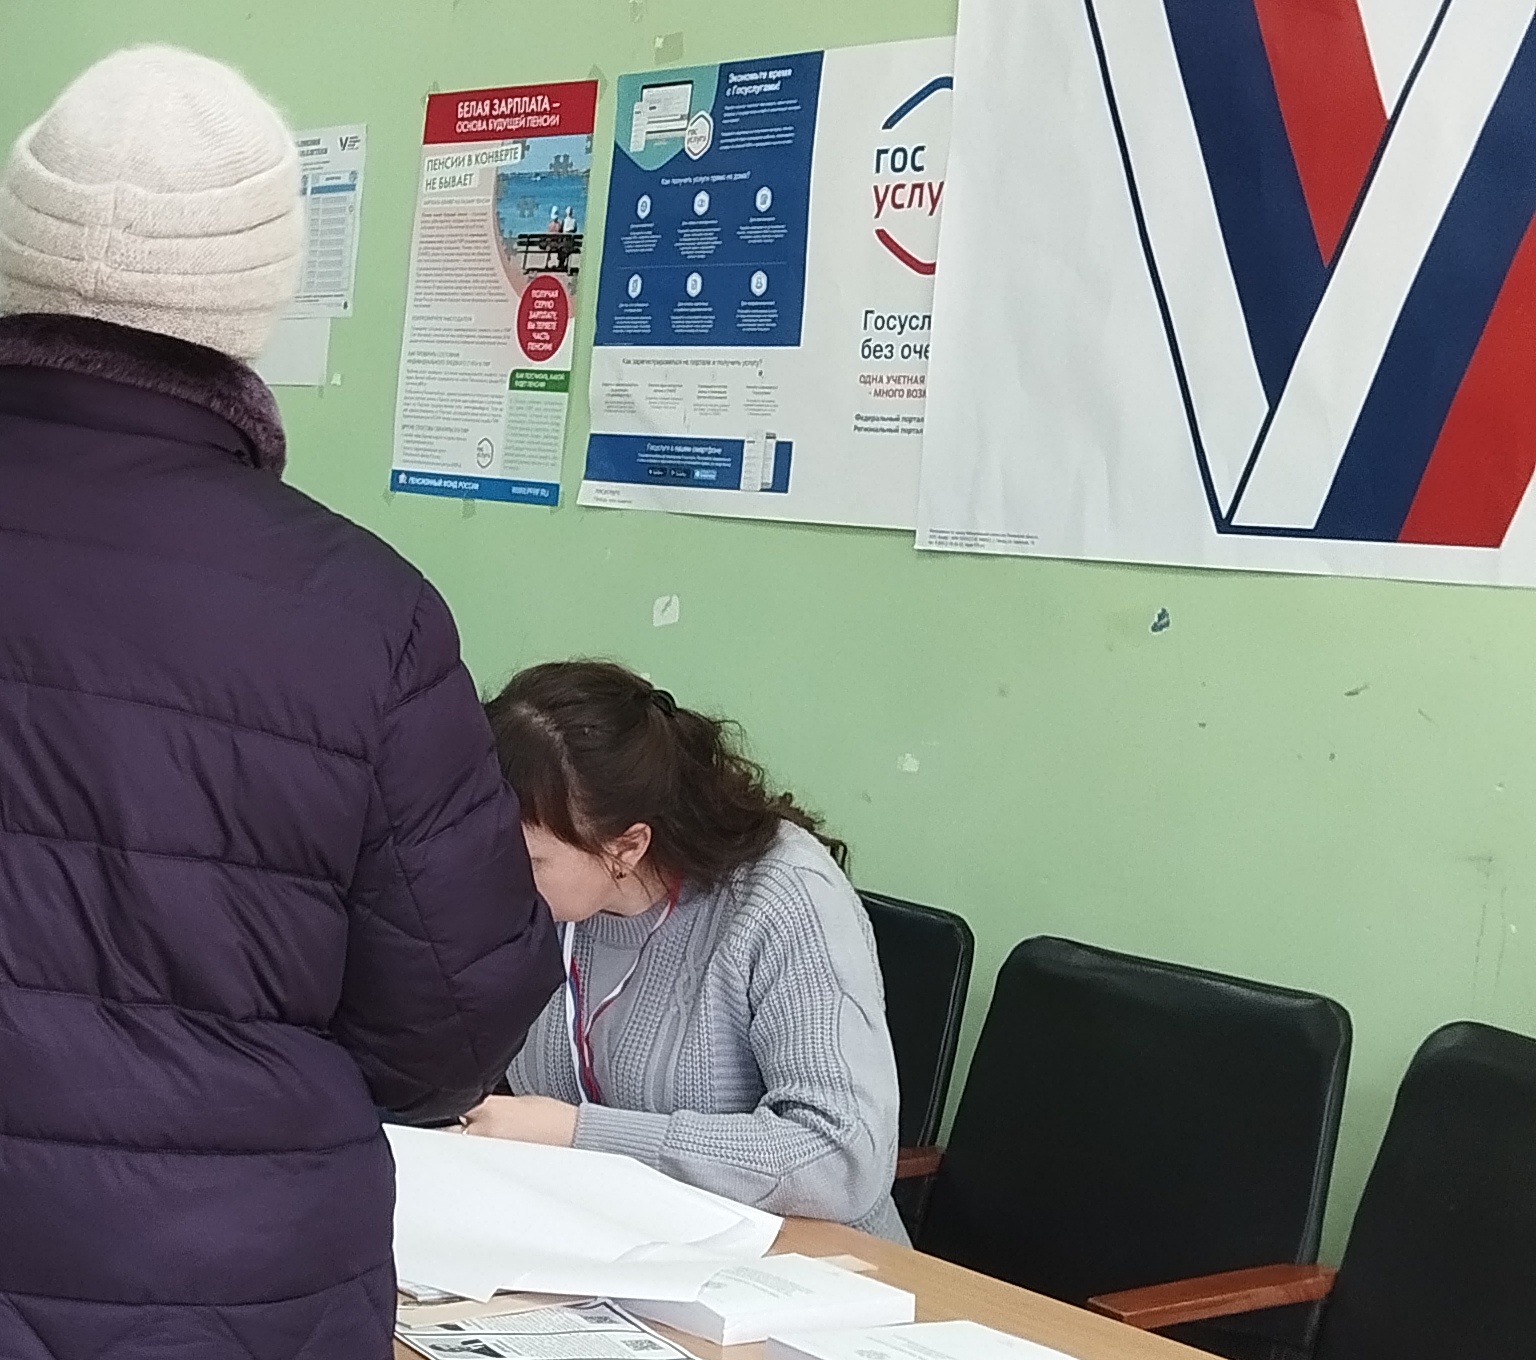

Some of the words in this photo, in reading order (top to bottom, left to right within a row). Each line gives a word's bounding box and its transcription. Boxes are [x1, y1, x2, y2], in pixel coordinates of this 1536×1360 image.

[457, 99, 490, 118] БЕЛАЯ
[492, 95, 550, 116] ЗАРПЛАТА
[456, 119, 487, 132] ОСНОВА
[488, 114, 525, 131] БУДУЩЕЙ
[526, 114, 560, 127] ПЕНСИИ
[427, 154, 466, 171] ПЕНСИИ
[467, 154, 472, 166] В
[474, 147, 519, 165] КОНВЕРТЕ
[875, 145, 926, 173] гос
[425, 177, 437, 190] НЕ
[439, 173, 474, 189] БЫВАЕТ
[873, 181, 945, 219] услу
[863, 310, 932, 335] Госусл
[861, 338, 894, 359] без
[859, 374, 883, 386] ОДНА
[886, 374, 925, 385] УЧЕТНАЯ
[873, 389, 904, 398] МНОГО
